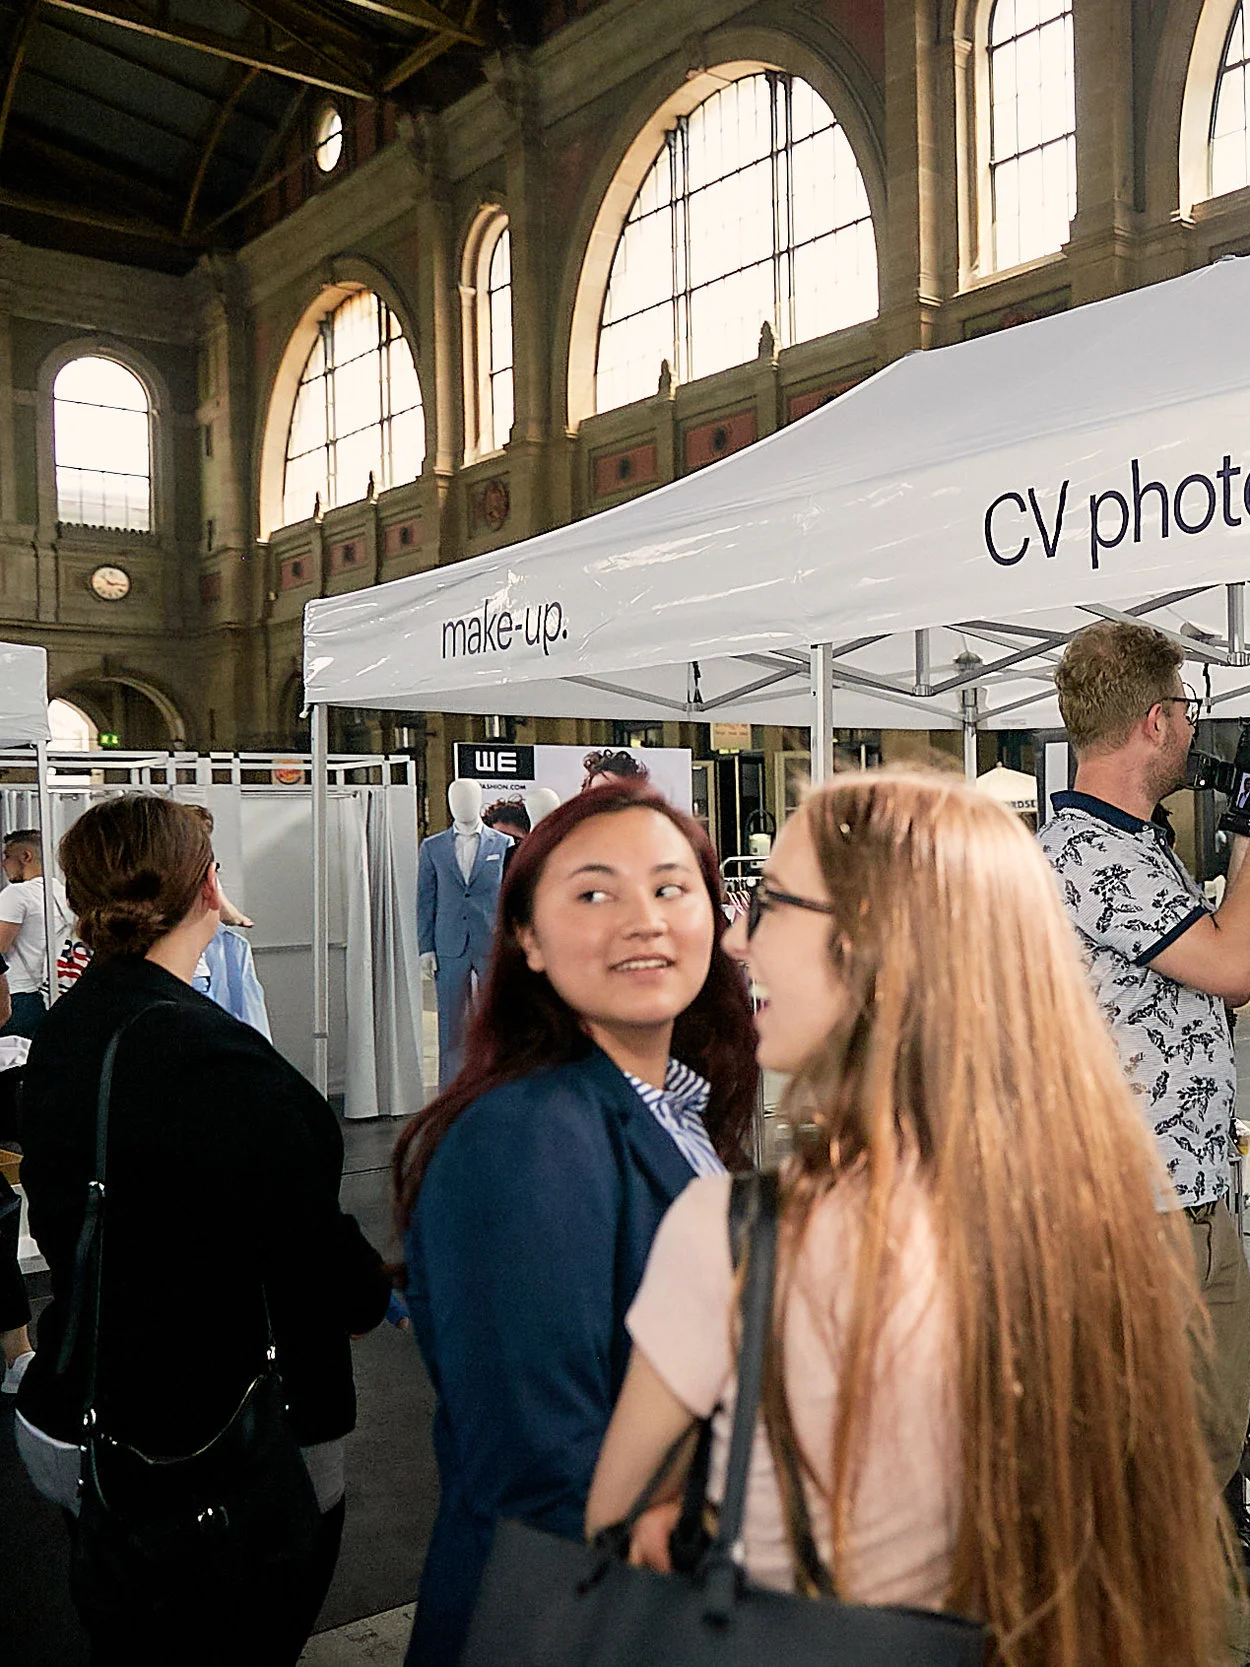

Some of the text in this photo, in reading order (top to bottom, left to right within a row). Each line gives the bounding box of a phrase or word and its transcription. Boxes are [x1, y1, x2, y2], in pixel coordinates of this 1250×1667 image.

[984, 480, 1069, 566] CV
[442, 599, 568, 659] make-up.
[475, 751, 517, 772] WE
